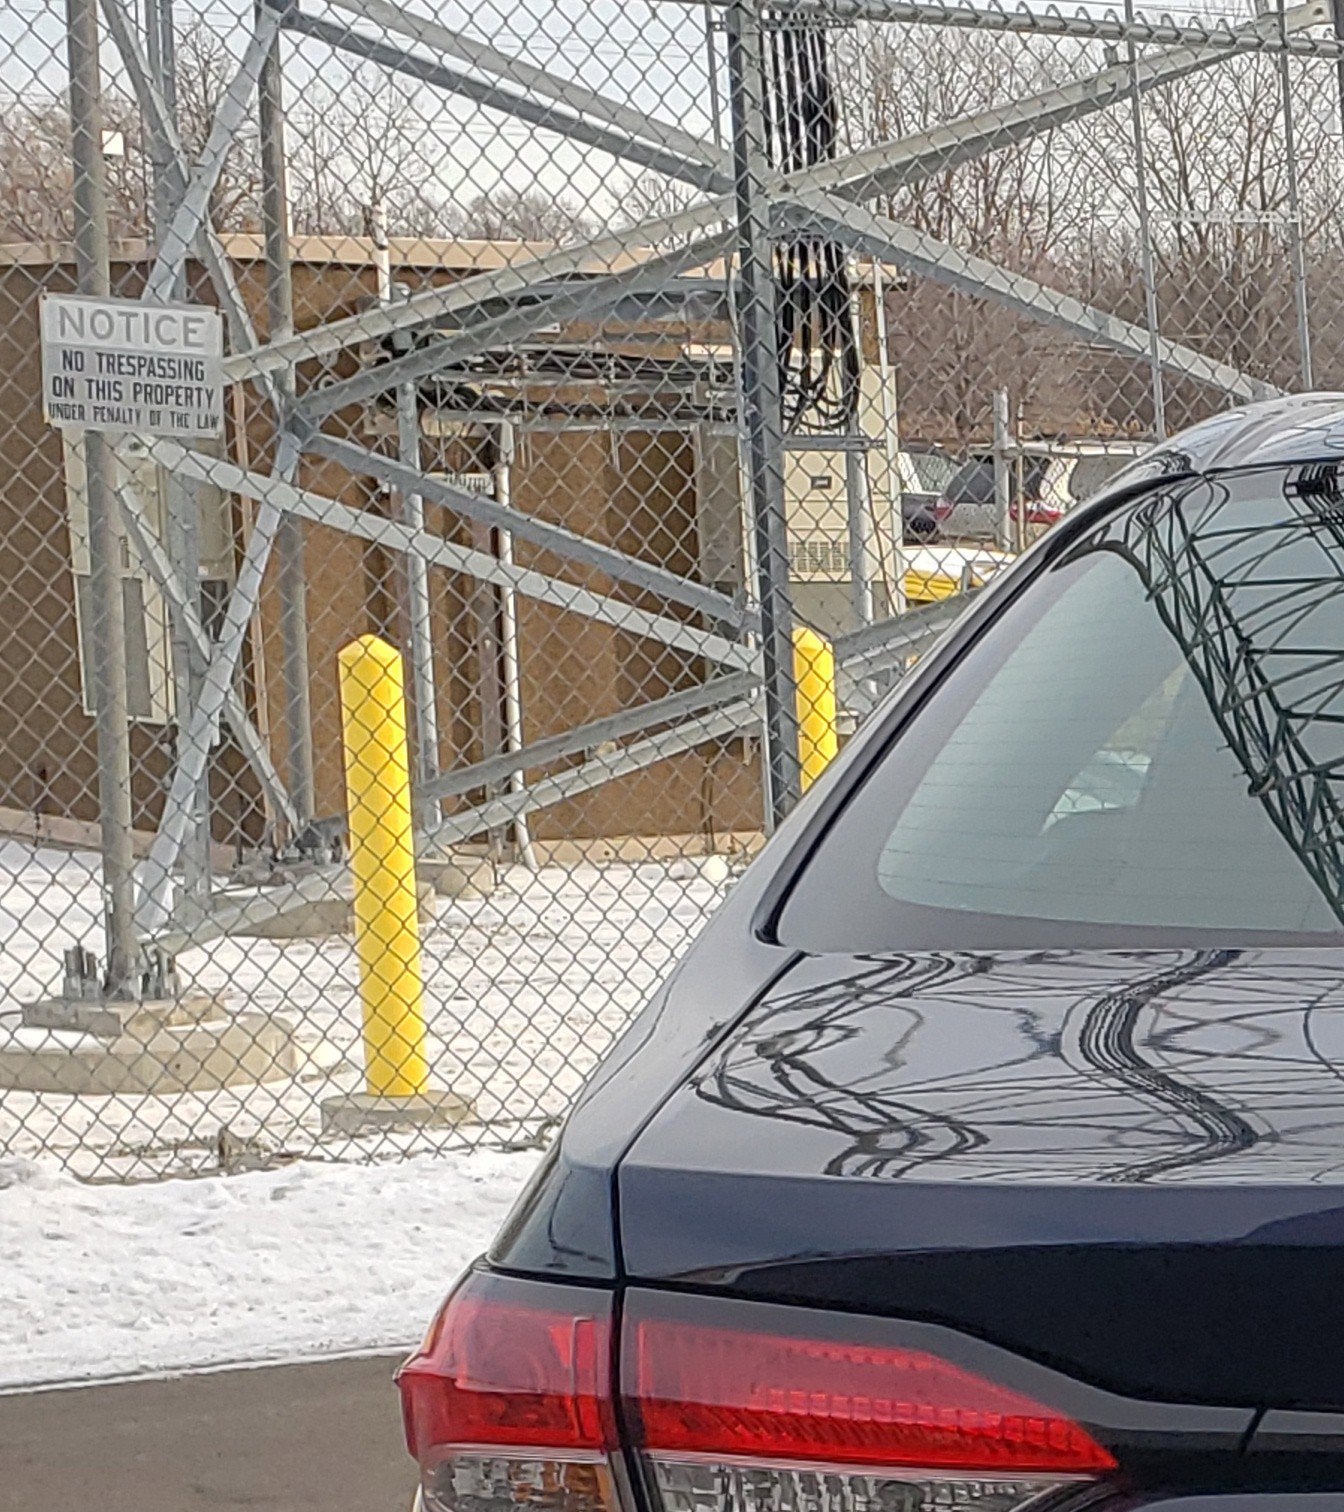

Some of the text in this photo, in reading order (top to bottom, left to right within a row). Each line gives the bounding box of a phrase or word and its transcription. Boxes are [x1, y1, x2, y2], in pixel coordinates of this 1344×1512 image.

[58, 305, 206, 348] NOTICE
[62, 350, 205, 382] NO TRESPASSING
[52, 376, 215, 408] ON THIS PROPERTY
[48, 402, 220, 430] UNDER PENALTY OF THE LAW
